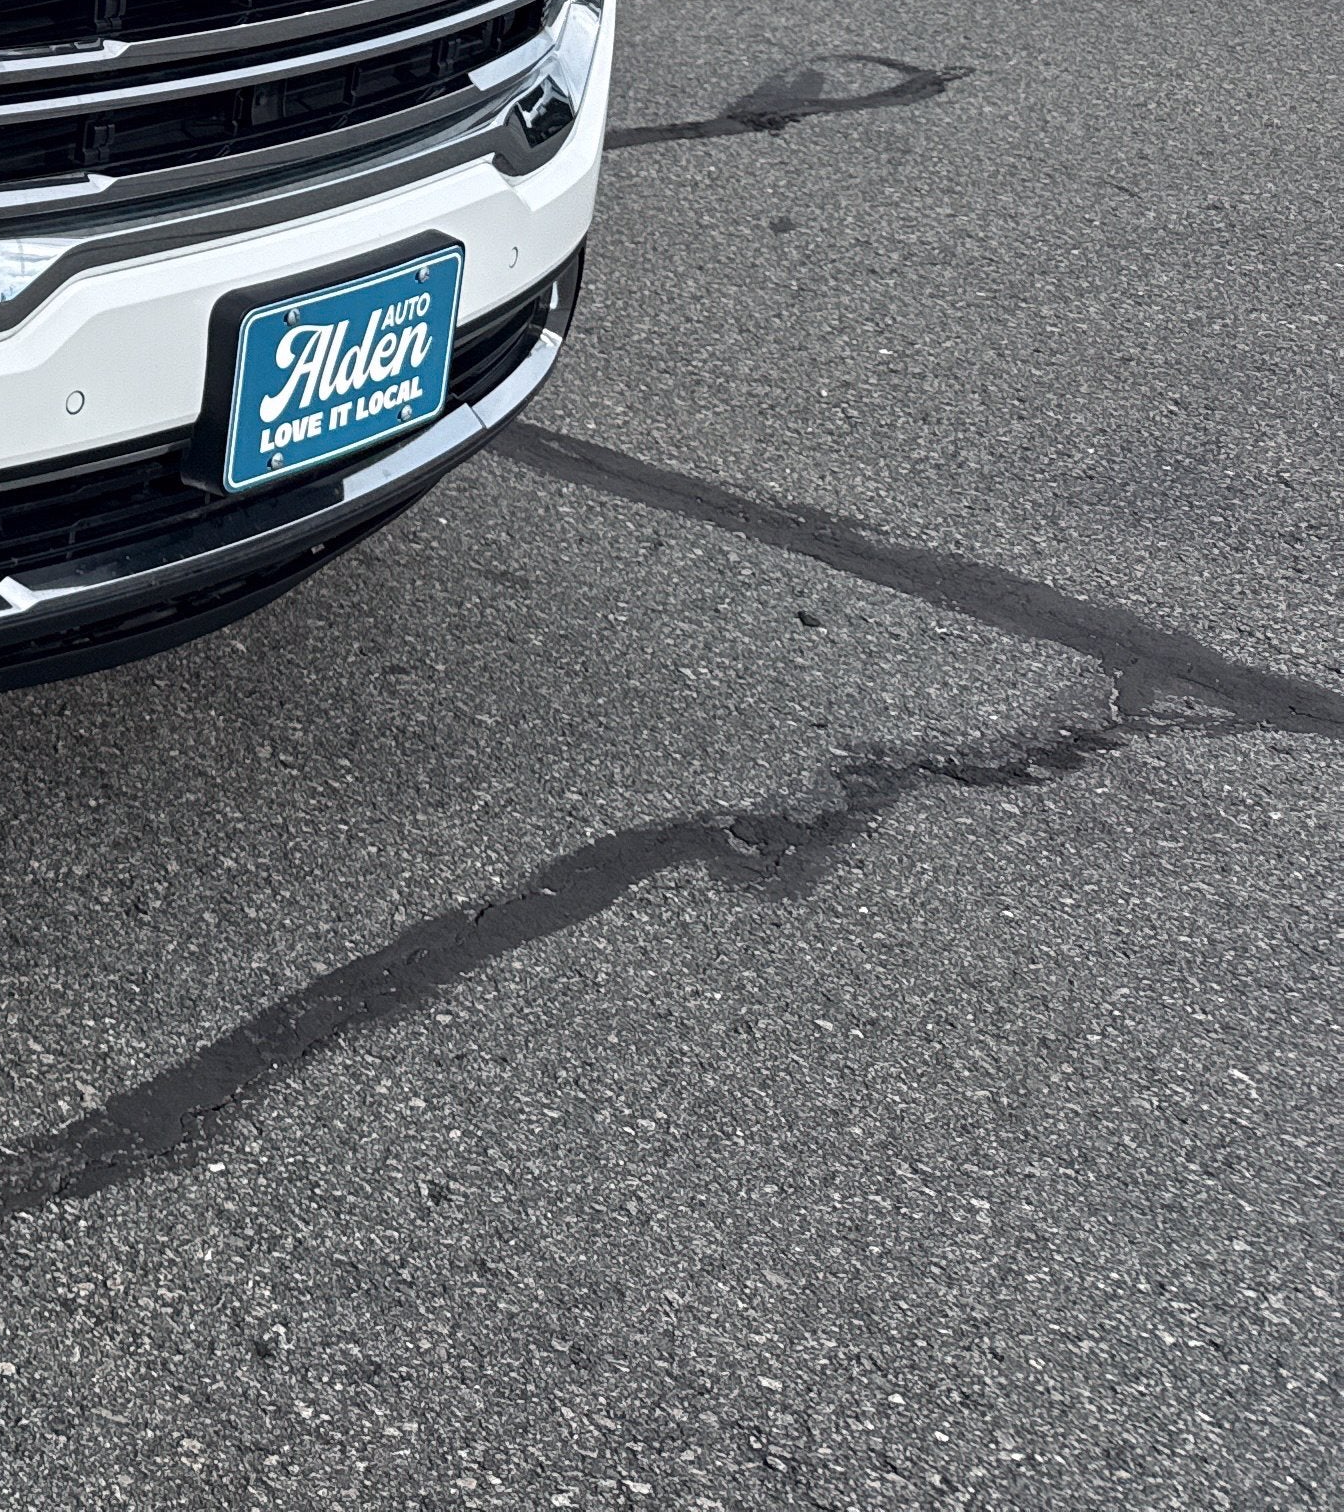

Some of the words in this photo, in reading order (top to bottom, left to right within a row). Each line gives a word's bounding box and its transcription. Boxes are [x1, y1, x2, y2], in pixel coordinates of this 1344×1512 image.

[381, 292, 431, 330] AUTO
[260, 308, 432, 422] Alden
[260, 411, 323, 453] LOVE
[328, 401, 352, 430] IT
[355, 376, 423, 420] LOCAL
